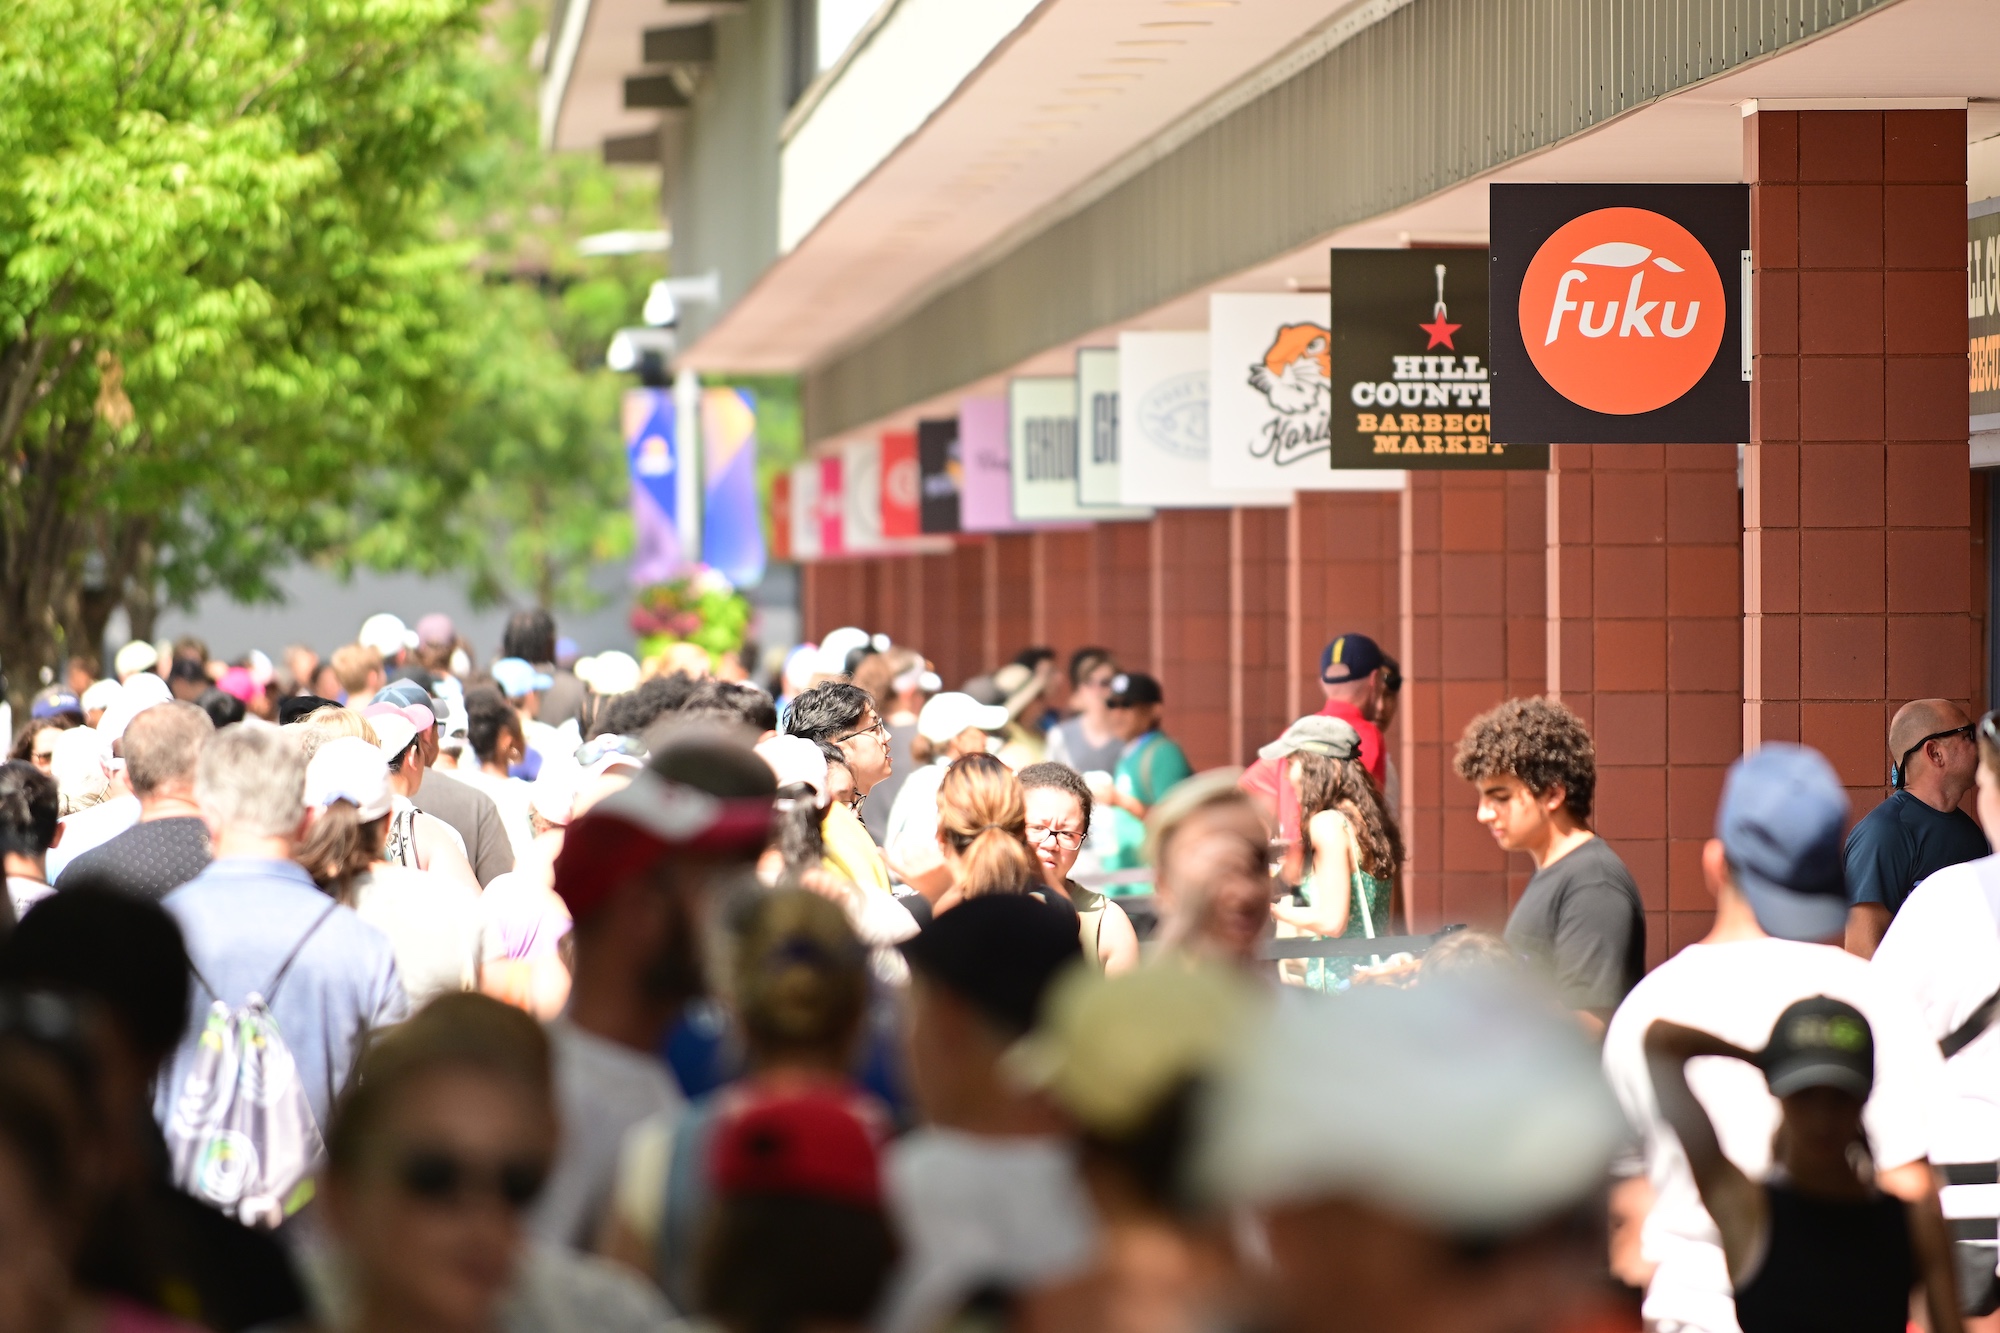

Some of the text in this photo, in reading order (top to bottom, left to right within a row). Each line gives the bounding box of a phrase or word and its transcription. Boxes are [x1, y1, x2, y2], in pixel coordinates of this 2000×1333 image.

[1544, 269, 1700, 346] fuku
[1393, 355, 1488, 380] HILL
[1969, 333, 2000, 393] BECU
